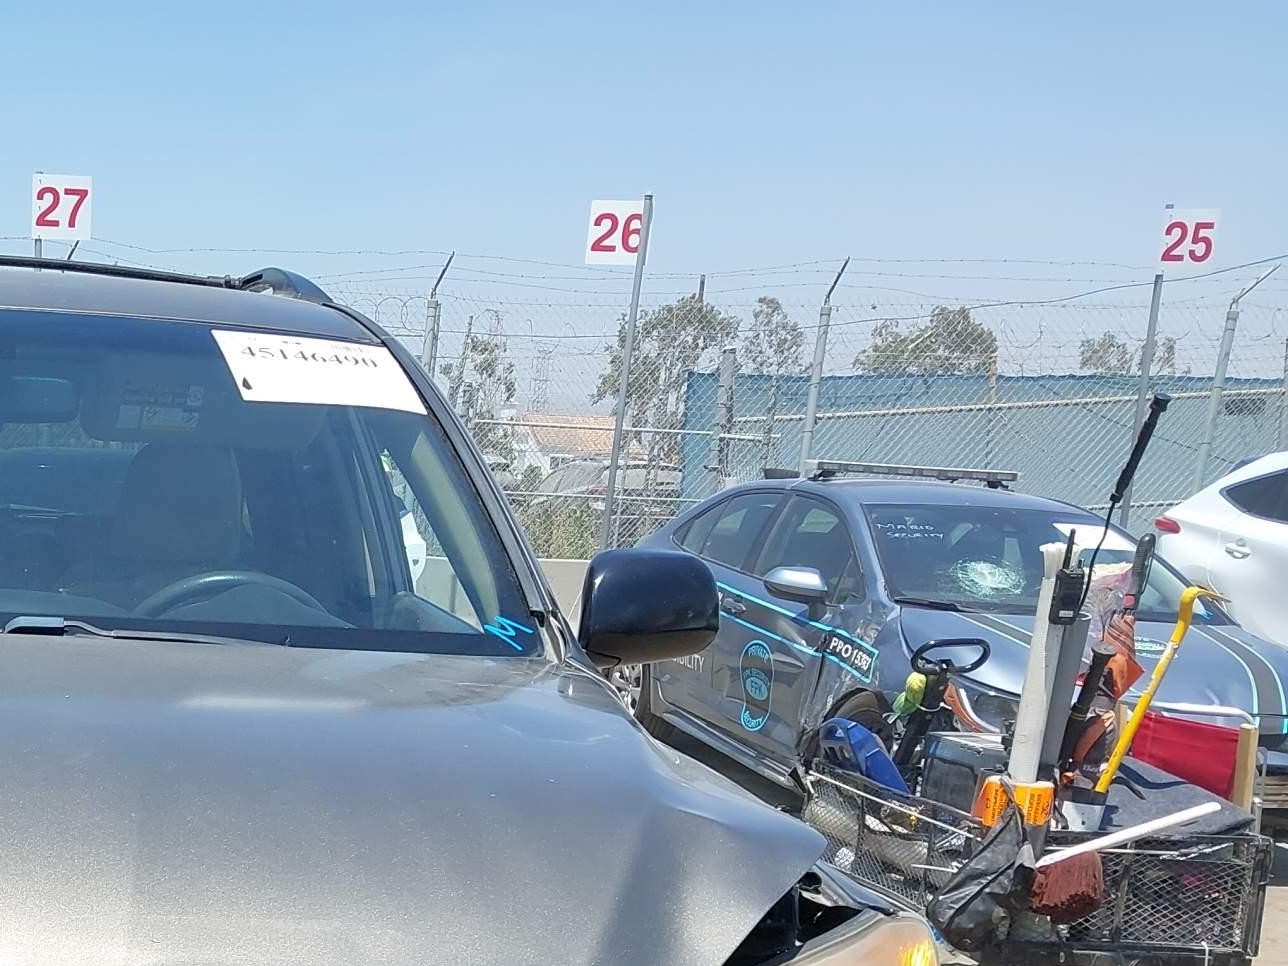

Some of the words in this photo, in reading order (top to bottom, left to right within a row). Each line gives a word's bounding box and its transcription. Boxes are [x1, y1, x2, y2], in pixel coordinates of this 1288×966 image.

[35, 186, 89, 228] 27
[591, 212, 643, 253] 26
[1161, 221, 1215, 262] 25
[829, 636, 852, 658] PPO
